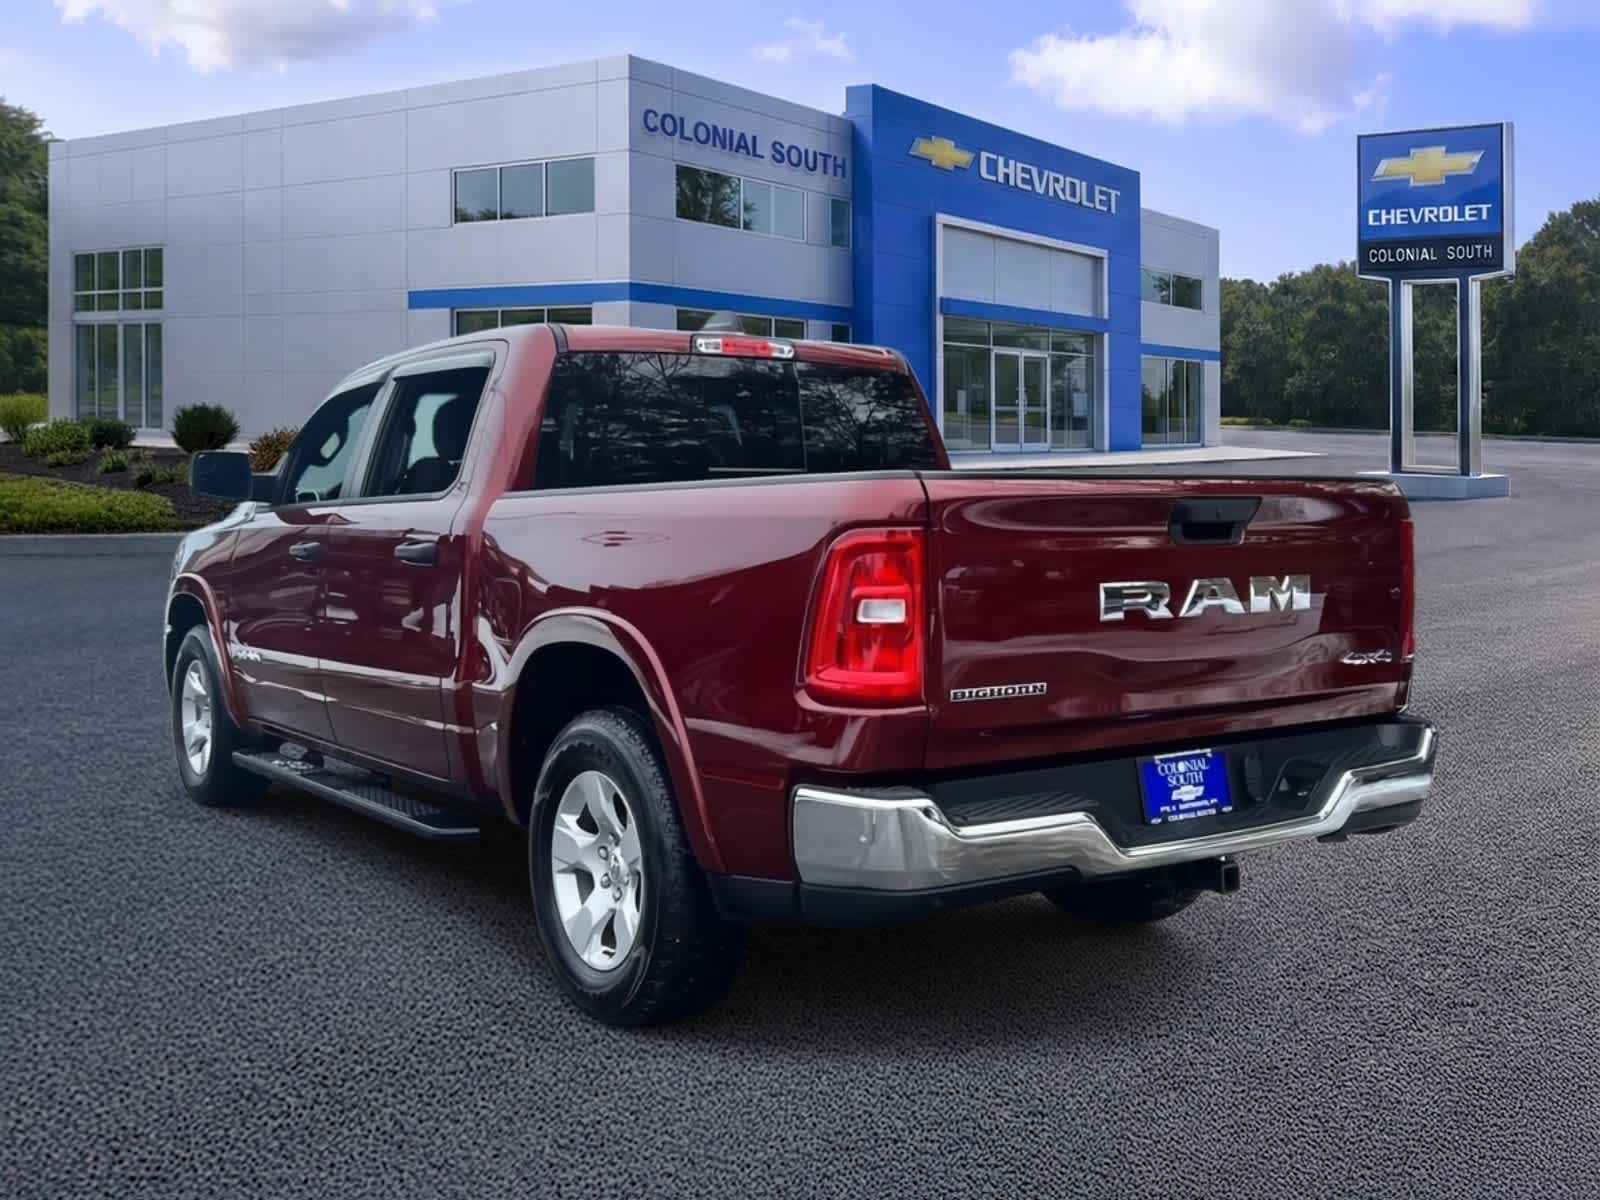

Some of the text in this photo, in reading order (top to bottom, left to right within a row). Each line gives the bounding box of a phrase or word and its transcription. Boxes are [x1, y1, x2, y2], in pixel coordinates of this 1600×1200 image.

[643, 109, 846, 179] COLONIAL SOUTH
[979, 151, 1121, 214] CHEVROLET
[1368, 204, 1492, 225] CHEVROLET
[1369, 244, 1493, 263] COLONIAL SOUTH
[1099, 574, 1311, 622] RAM
[949, 682, 1047, 702] BIGHORN
[1158, 758, 1210, 775] COLONIAL
[1167, 771, 1204, 787] SOUTH
